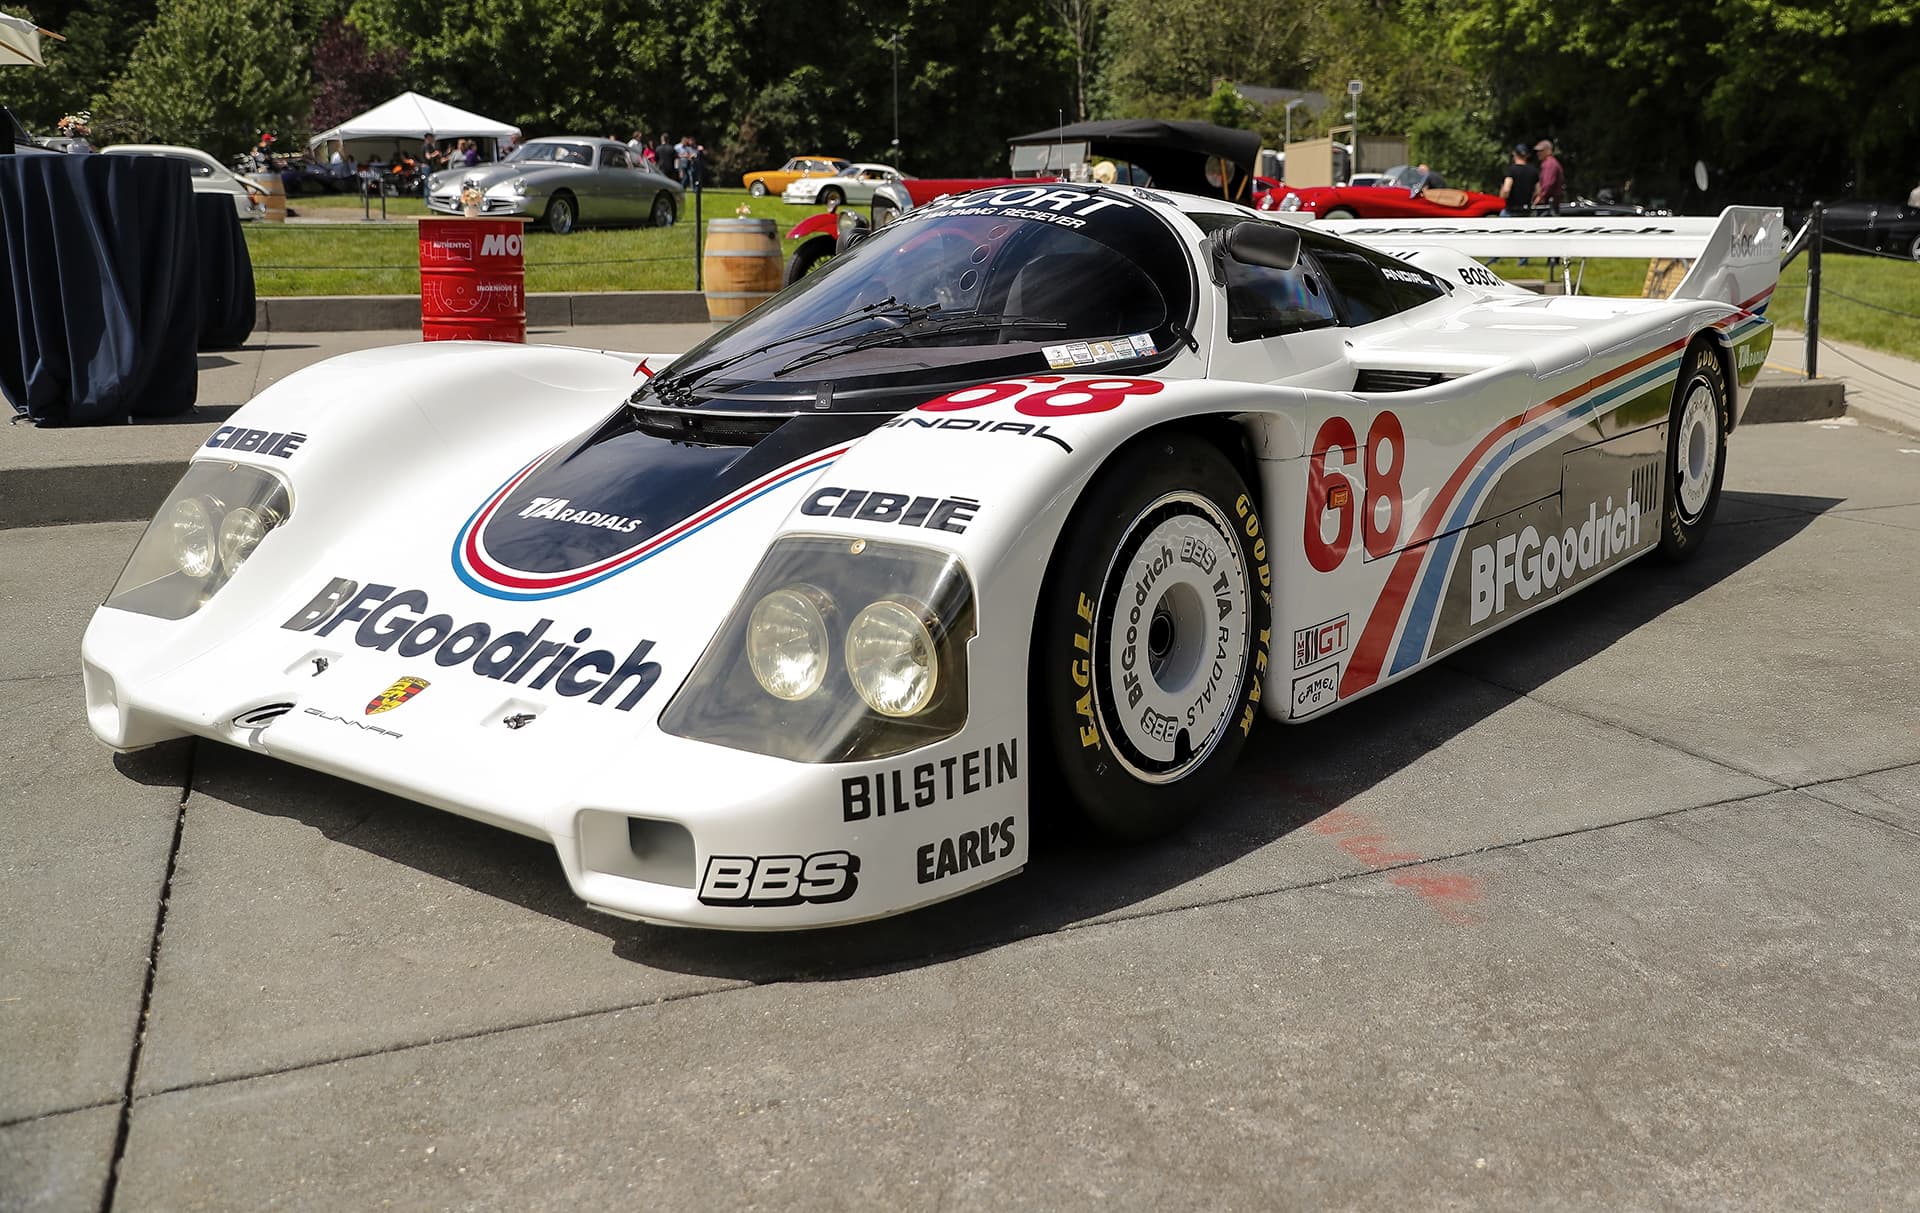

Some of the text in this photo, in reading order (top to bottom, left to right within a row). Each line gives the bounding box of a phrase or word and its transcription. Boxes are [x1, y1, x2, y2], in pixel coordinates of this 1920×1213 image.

[1000, 207, 1087, 229] RECIEVER
[480, 234, 524, 256] MO
[1381, 267, 1431, 286] ANDIAL
[917, 376, 1165, 417] 68
[1303, 410, 1406, 573] 68
[555, 508, 642, 533] RADIALS
[1180, 536, 1217, 575] BBS
[1470, 487, 1641, 627] BFGoodrich
[281, 576, 662, 712] BFGoodrich
[1121, 545, 1174, 710] BFGoodrich
[1319, 619, 1347, 655] GT
[1072, 591, 1102, 750] EAGLE
[1186, 625, 1229, 727] RADIALS
[1298, 678, 1334, 705] CAMEL
[1312, 691, 1322, 703] GT
[304, 708, 404, 740] GUNNAR
[1140, 706, 1178, 743] BBS
[842, 737, 1018, 823] BILSTEIN
[917, 816, 1016, 885] EARL'S
[698, 850, 861, 908] BBS
